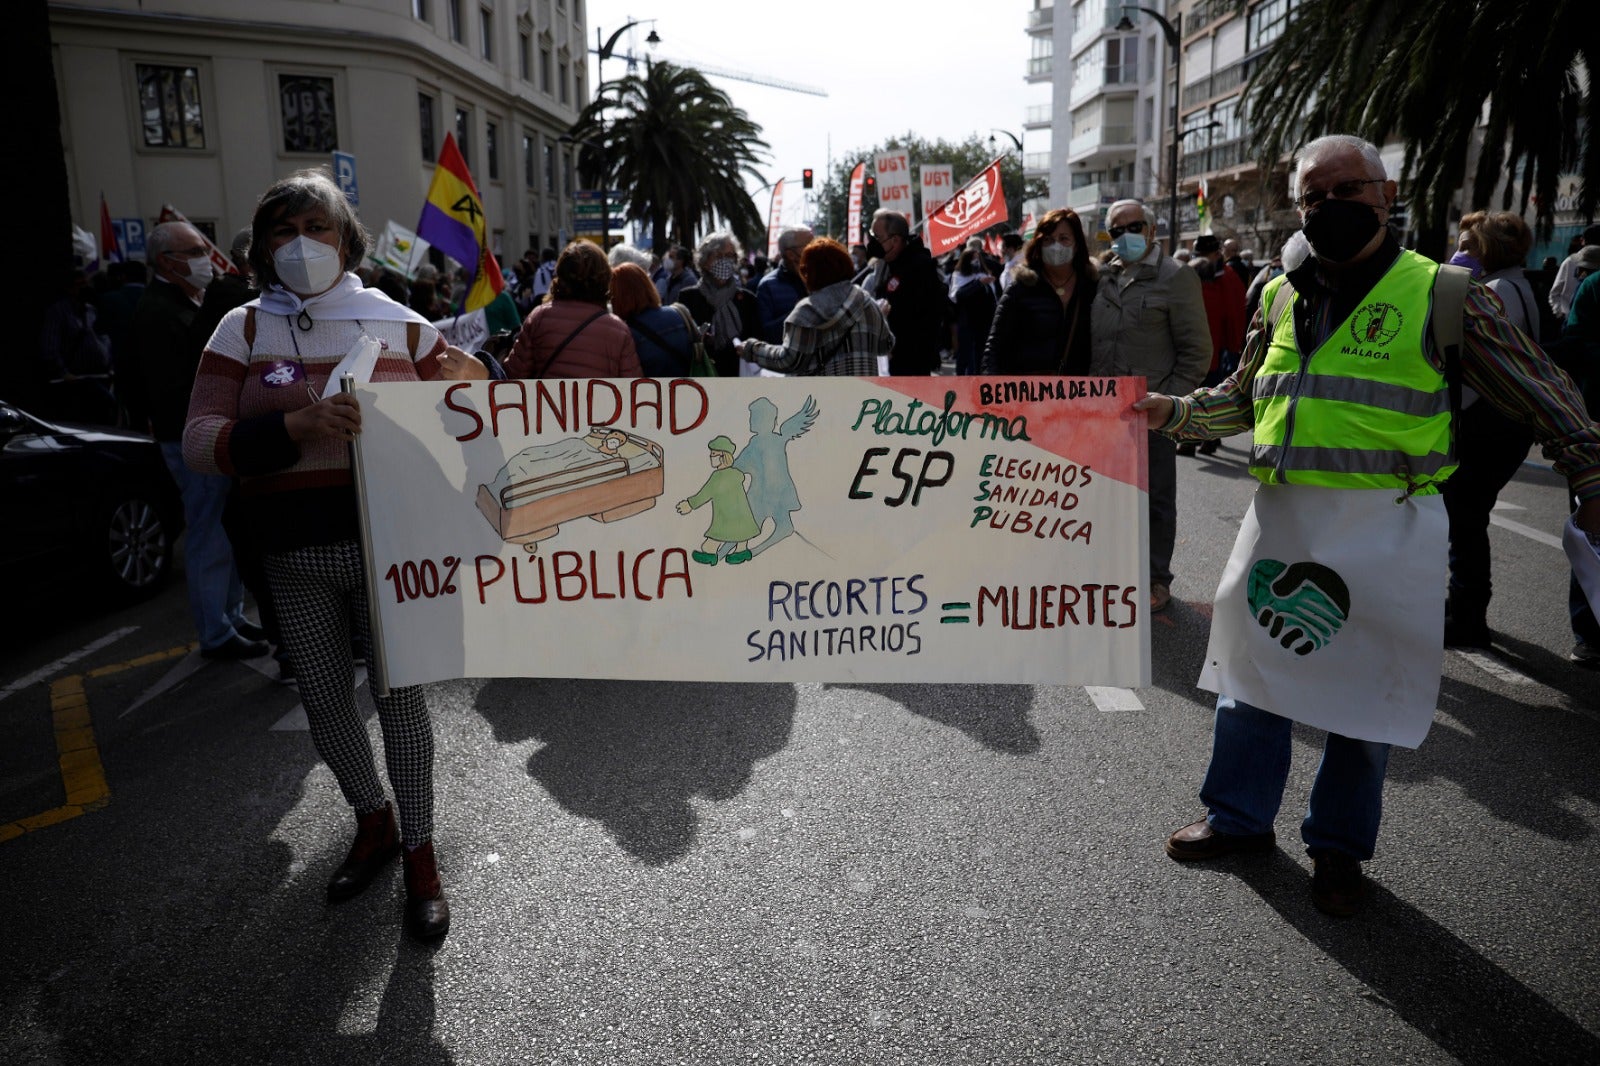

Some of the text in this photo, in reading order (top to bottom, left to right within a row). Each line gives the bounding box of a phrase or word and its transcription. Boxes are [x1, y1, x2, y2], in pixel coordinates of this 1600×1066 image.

[878, 156, 906, 173] UGT
[924, 171, 950, 187] UGT
[882, 184, 910, 201] UGT
[1340, 345, 1390, 361] MÁLAGA
[444, 378, 709, 441] SANIDAD
[851, 390, 1032, 447] Plataforma
[848, 446, 955, 507] ESP
[979, 454, 1093, 488] ELEGIMOS
[973, 480, 1079, 511] SANIDAD
[970, 505, 1093, 545] PÚBLICA
[385, 547, 694, 605] 100% PÚBLICA
[768, 574, 928, 621] RECORTES
[977, 583, 1137, 630] MUERTES
[746, 621, 922, 662] SANITARIOS
